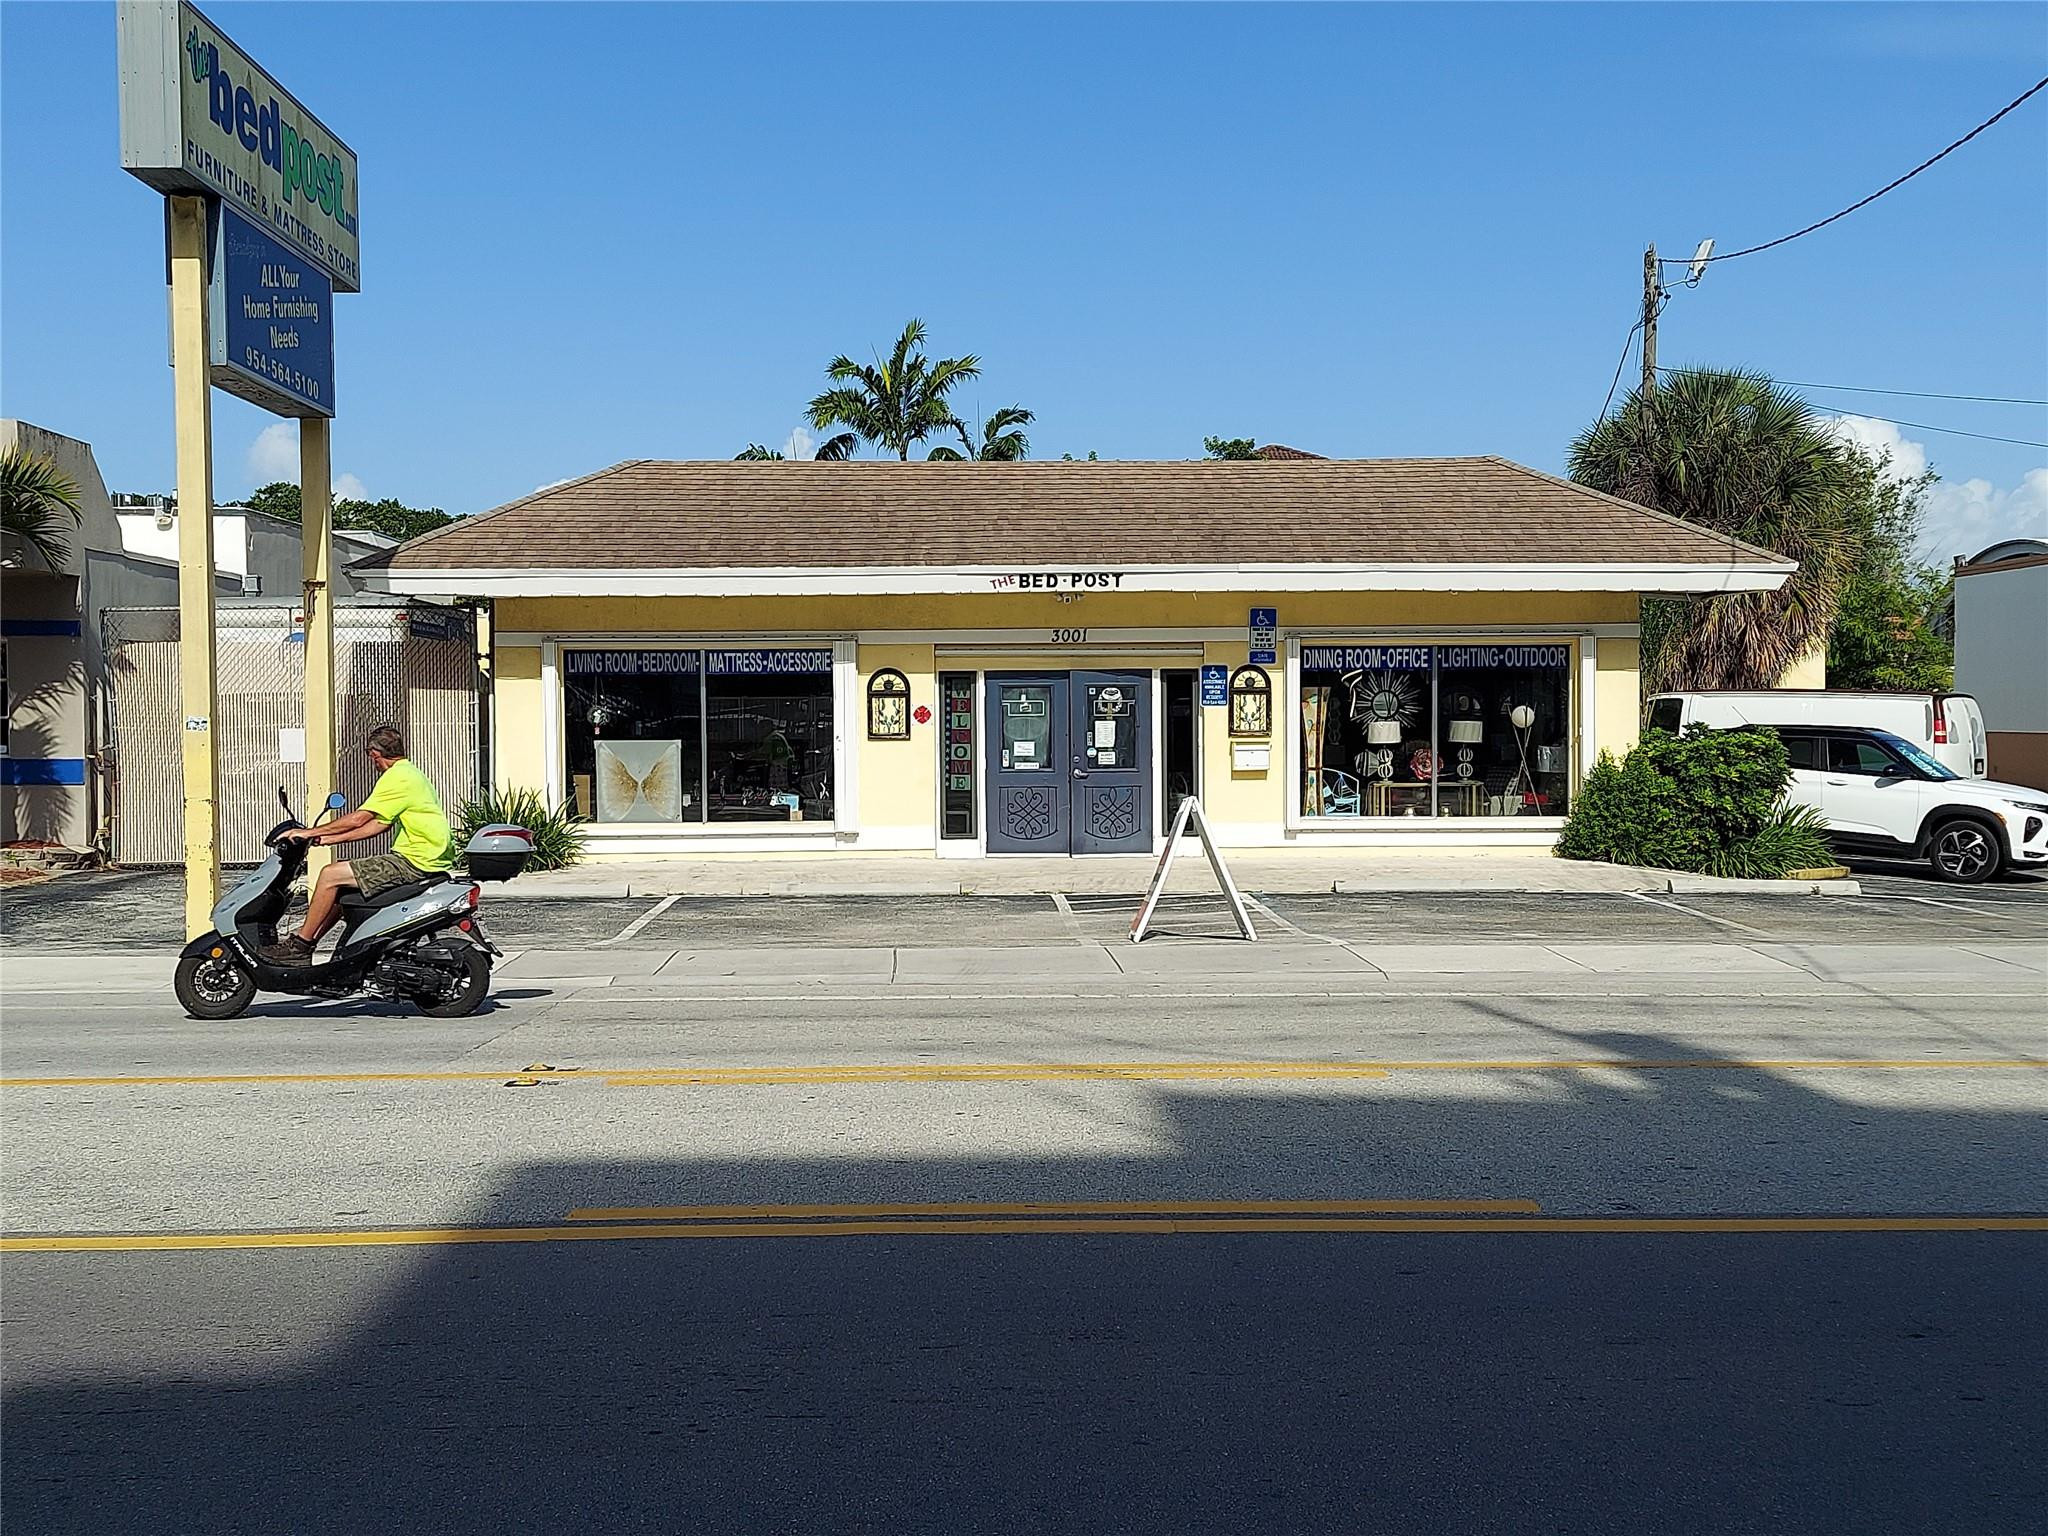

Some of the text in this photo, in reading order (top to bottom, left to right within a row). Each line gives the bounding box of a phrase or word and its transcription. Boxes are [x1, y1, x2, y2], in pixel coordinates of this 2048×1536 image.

[186, 25, 209, 83] the
[187, 139, 257, 206] FURNITURE
[260, 195, 268, 216] &
[273, 203, 324, 257] MATTRESS
[327, 243, 357, 280] STORE
[261, 264, 300, 289] ALL Your
[243, 295, 319, 324] Home Furnishing
[270, 326, 299, 349] Needs
[246, 346, 319, 400] 954-564-5100
[990, 574, 1016, 590] THE
[1051, 628, 1088, 643] 3001
[568, 653, 603, 673] LIVING
[1303, 648, 1343, 669] DINING
[229, 935, 259, 969] ITALICA
